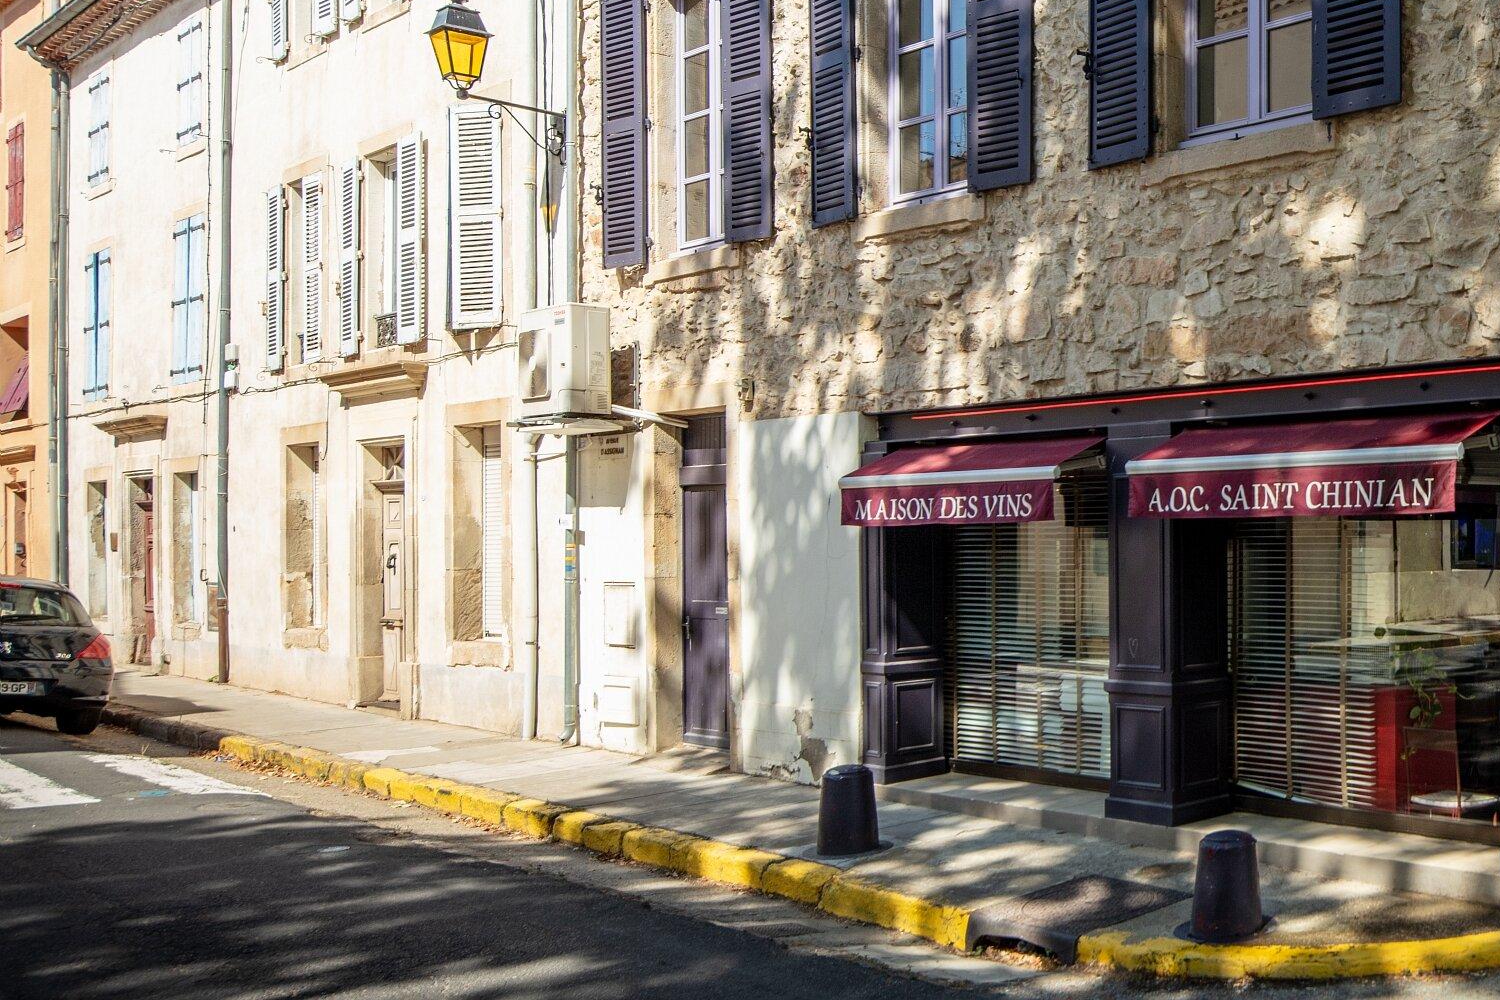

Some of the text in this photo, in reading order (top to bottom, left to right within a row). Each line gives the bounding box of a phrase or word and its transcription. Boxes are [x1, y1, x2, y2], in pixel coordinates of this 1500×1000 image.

[855, 493, 1033, 521] MAISON DES VINS
[1149, 477, 1434, 512] A.O.C. SAINT CHINIAN
